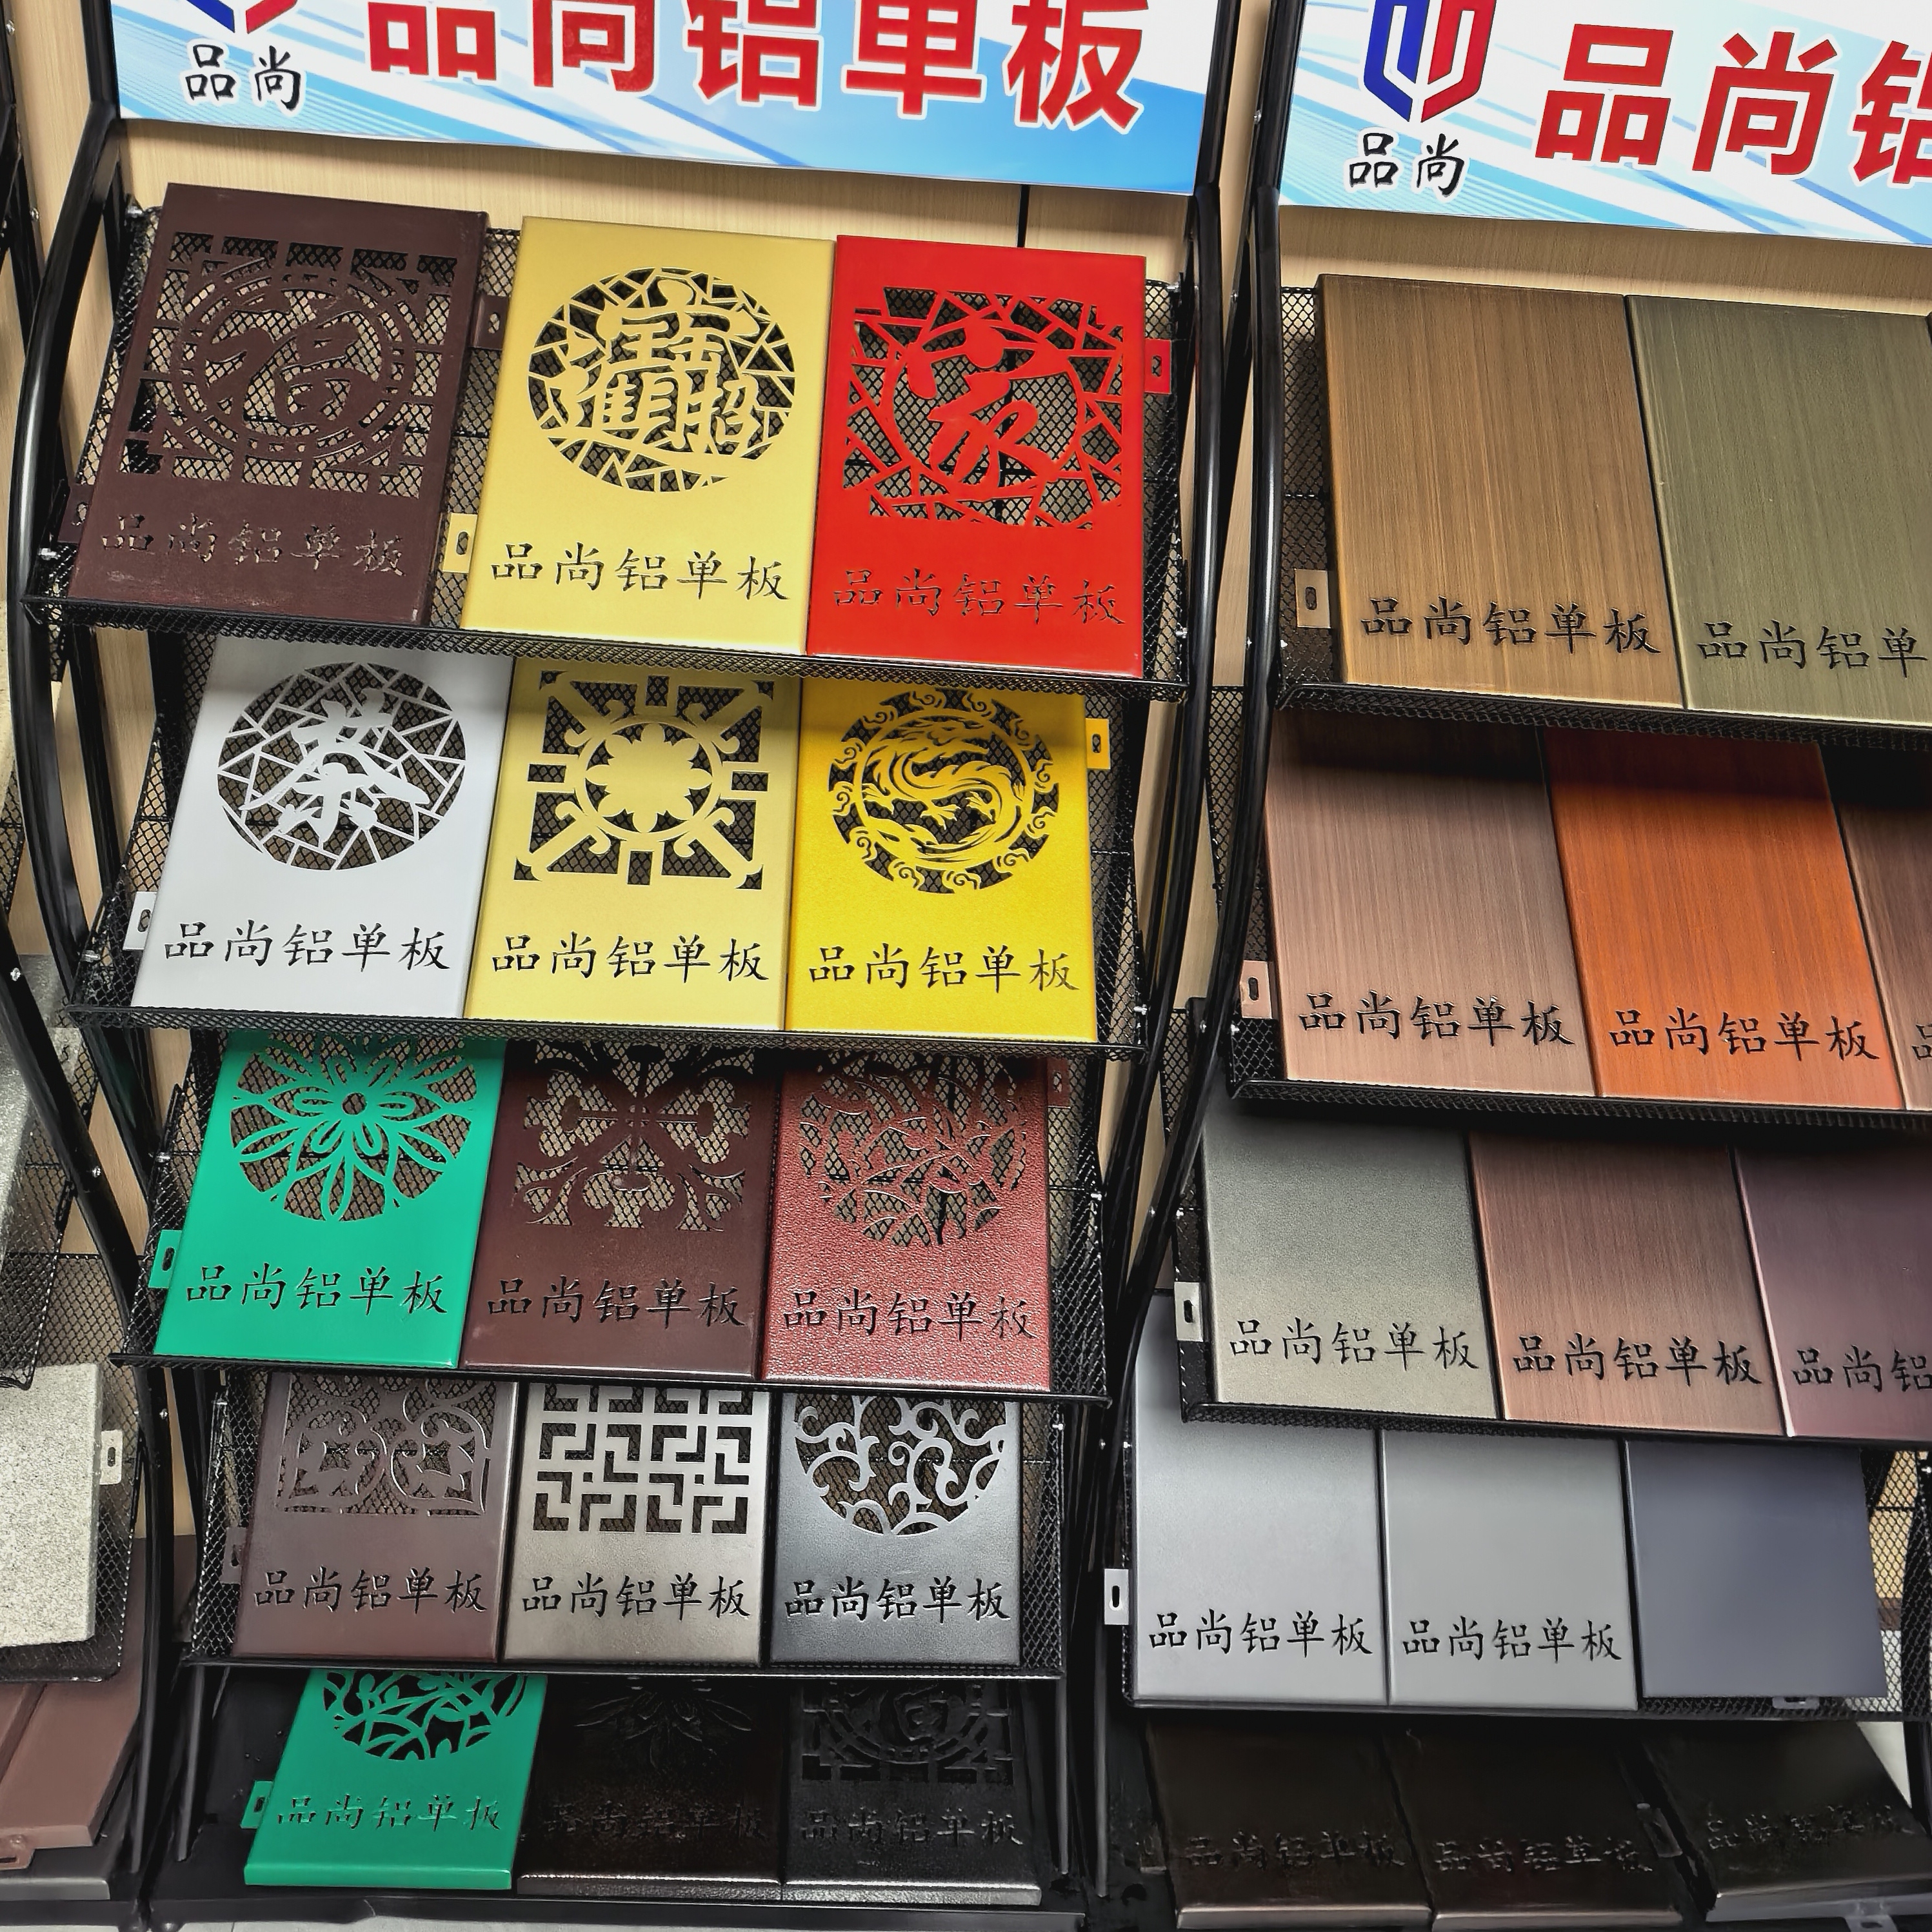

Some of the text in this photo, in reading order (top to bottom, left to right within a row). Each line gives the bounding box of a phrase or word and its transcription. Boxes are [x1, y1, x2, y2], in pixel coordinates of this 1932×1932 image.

[186, 45, 303, 110] 品尚
[1349, 133, 1465, 196] 品尚
[102, 513, 404, 575] 品尚铝单板
[492, 543, 790, 601] 品尚铝单板
[834, 568, 1125, 625] 品尚铝单板
[1361, 596, 1661, 654] 品尚铝单板
[1697, 619, 1929, 678] 品尚铝单
[164, 920, 450, 971] 品尚铝单板
[492, 931, 768, 983] 品尚铝单板
[809, 943, 1080, 993] 品尚铝单板
[1299, 990, 1575, 1046] 品尚铝单板
[1609, 1007, 1880, 1061] 品尚铝单板
[186, 1262, 448, 1315] 品尚铝单板
[487, 1276, 745, 1329] 品尚铝单板
[783, 1290, 1038, 1341] 品尚铝单板
[1229, 1319, 1480, 1371] 品尚铝单板
[1513, 1333, 1762, 1386] 品尚铝单板
[1791, 1345, 1932, 1392] 品尚铝
[254, 1566, 487, 1614] 品尚铝单板
[523, 1571, 751, 1620] 品尚铝单板
[785, 1575, 1010, 1624] 品尚铝单板
[1149, 1609, 1373, 1658] 品尚铝单板
[1403, 1617, 1622, 1663] 品尚铝单板
[277, 1794, 501, 1831] 品尚铝单板
